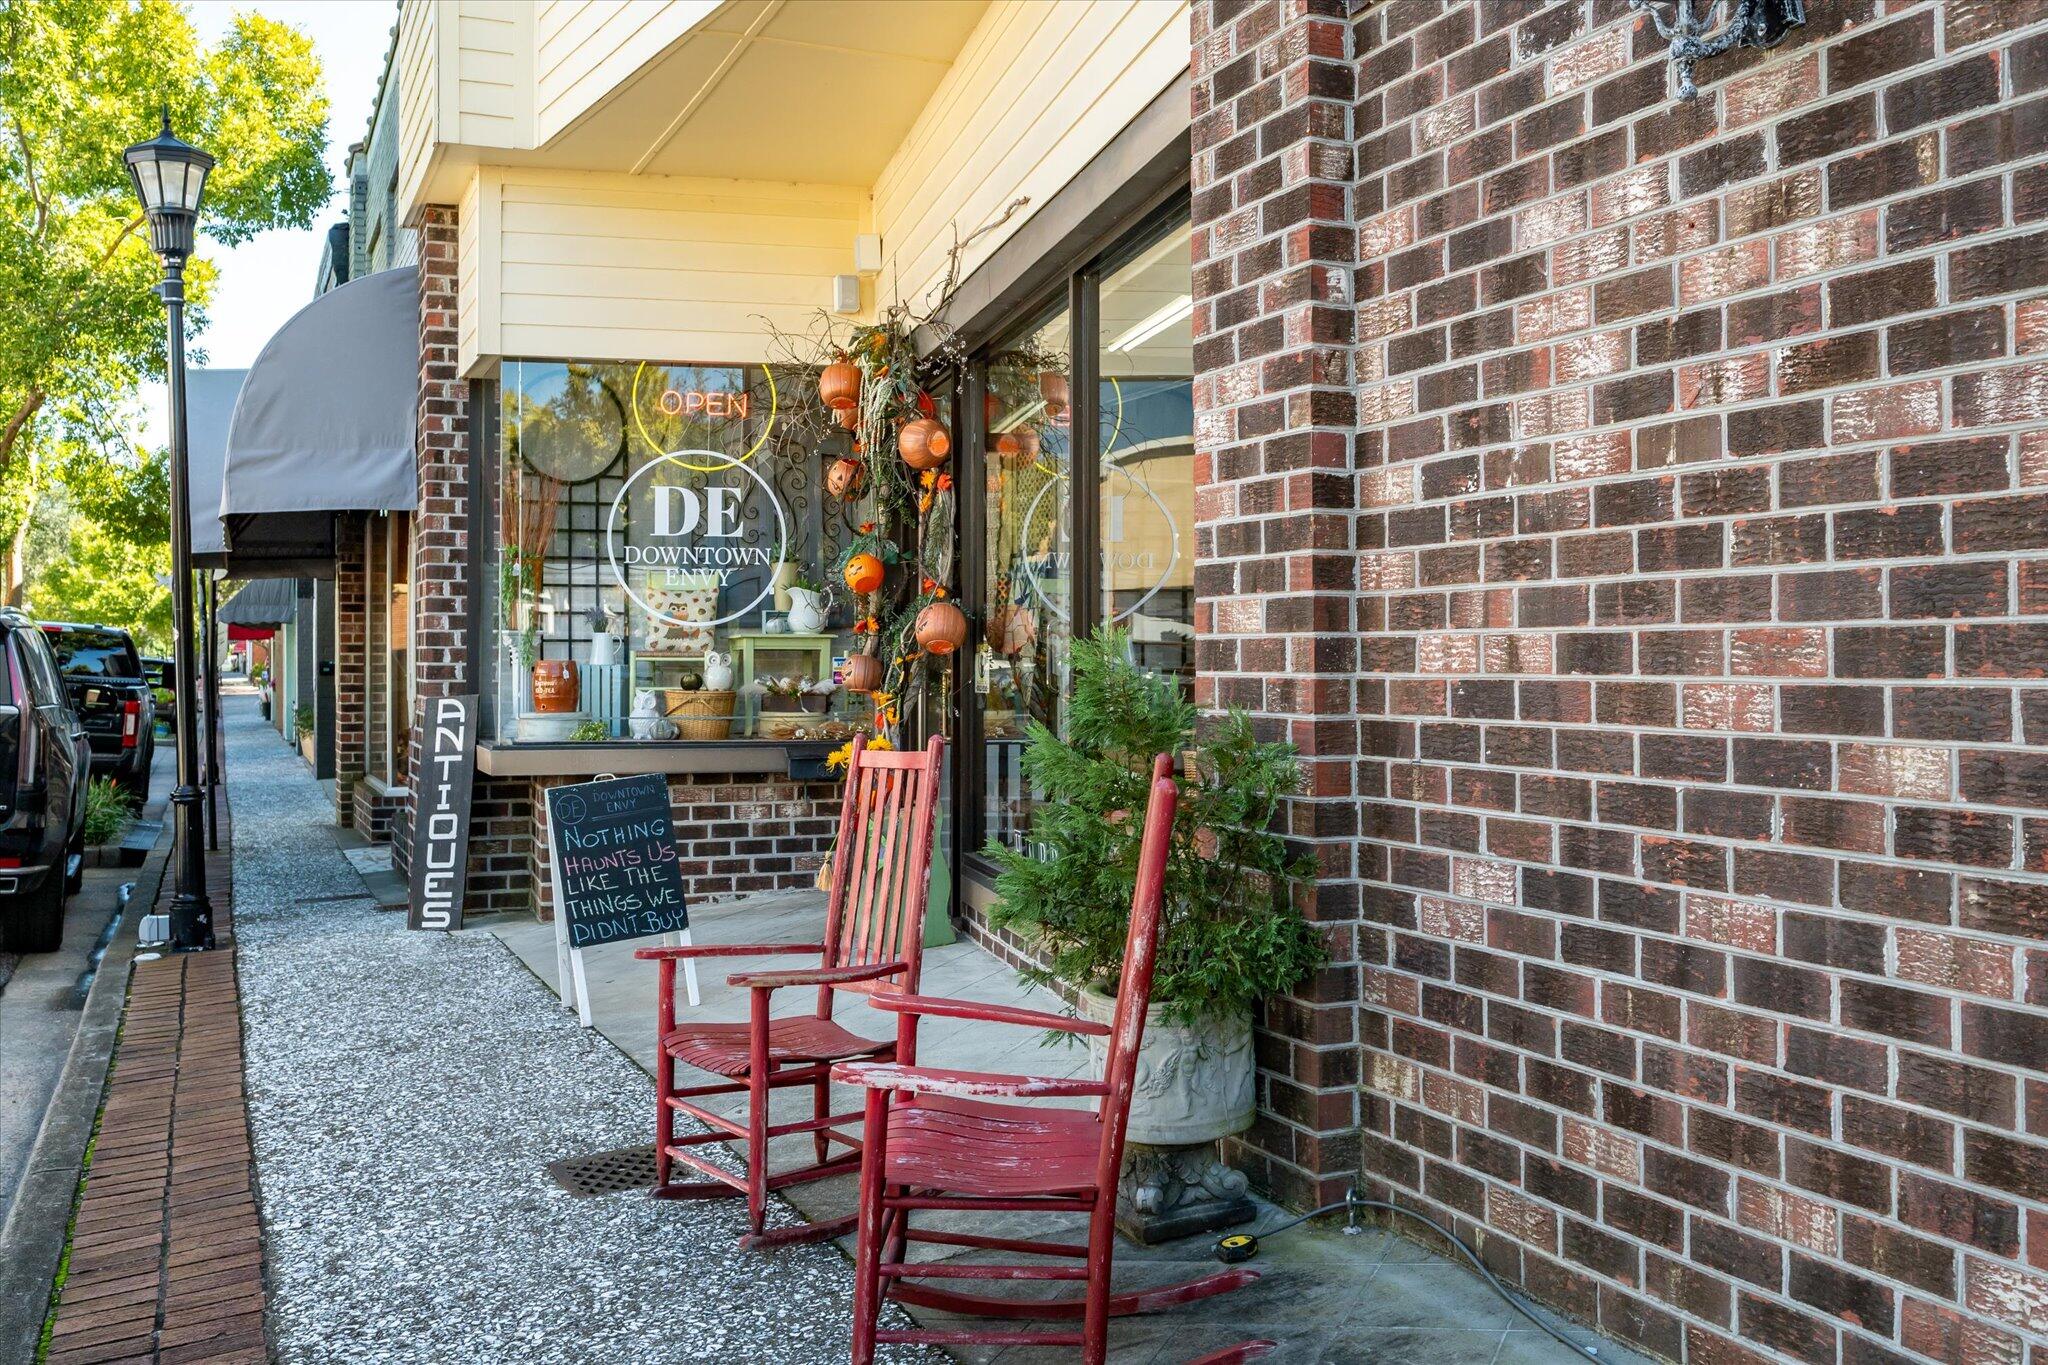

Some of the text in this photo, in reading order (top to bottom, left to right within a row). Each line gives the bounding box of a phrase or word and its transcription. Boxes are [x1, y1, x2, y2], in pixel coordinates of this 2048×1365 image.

[660, 390, 748, 419] OPEN
[650, 485, 744, 538] DE
[624, 546, 772, 566] DOWNTOWN
[666, 569, 732, 587] ENVY
[594, 785, 656, 802] DOWNTOWN
[606, 799, 637, 813] ENVY
[421, 699, 466, 928] ANTIQUES
[564, 819, 665, 851] NOTHING
[564, 850, 642, 876] HAUNTS
[567, 865, 669, 896] LIKE THE
[566, 887, 680, 919] THINGS WE
[641, 909, 684, 933] BUY
